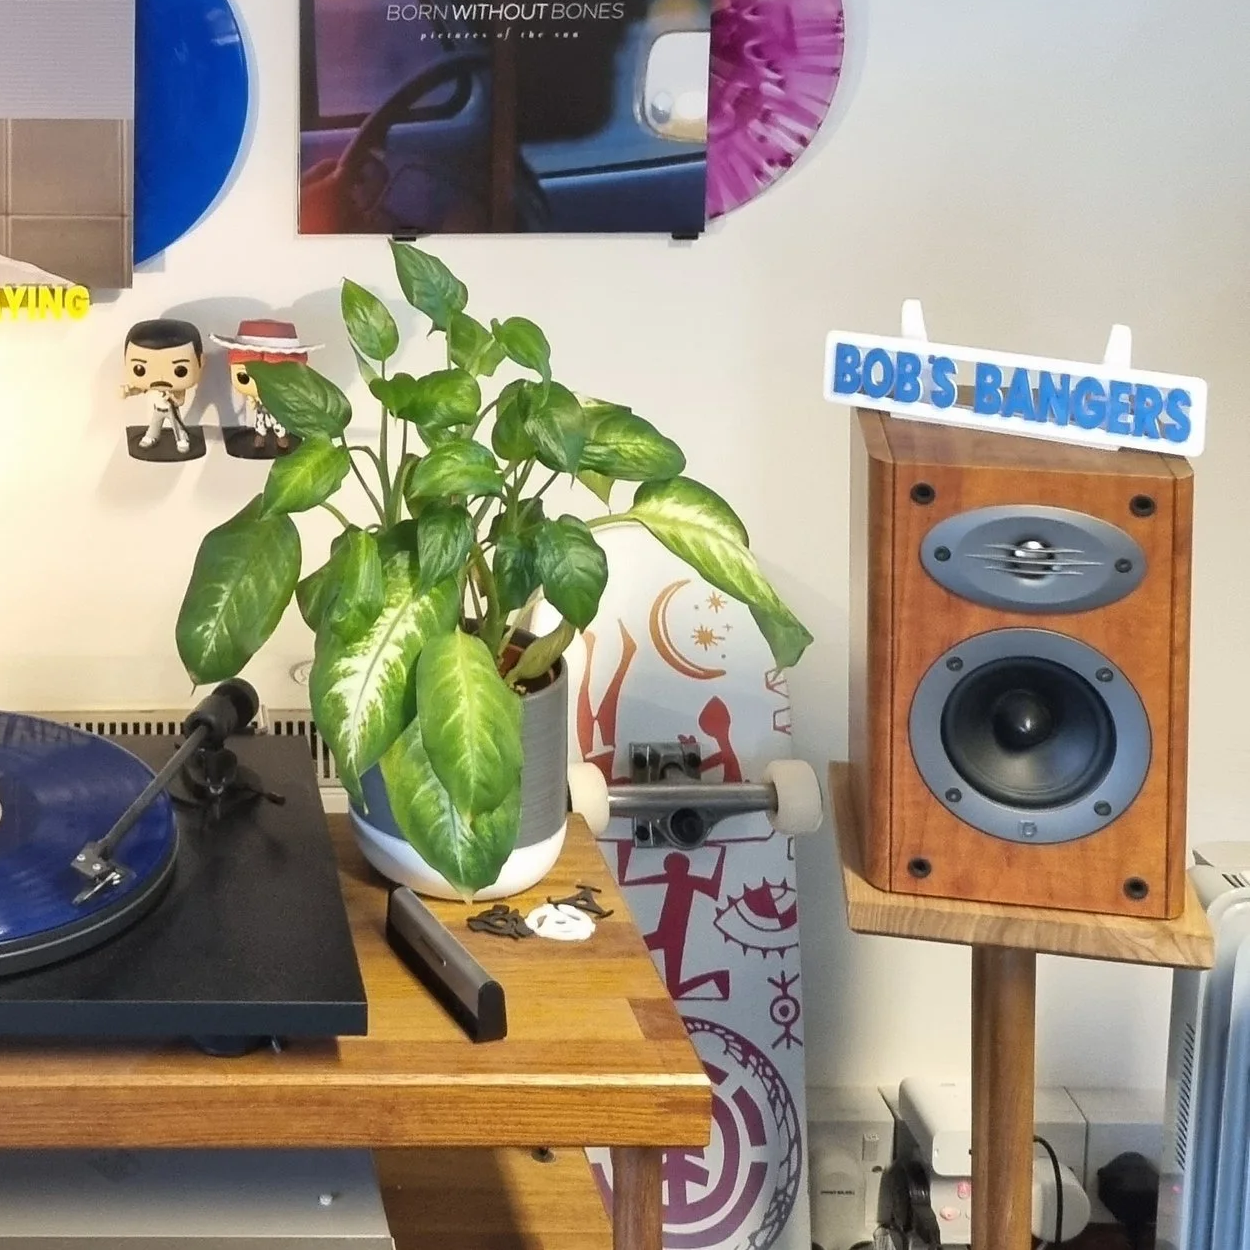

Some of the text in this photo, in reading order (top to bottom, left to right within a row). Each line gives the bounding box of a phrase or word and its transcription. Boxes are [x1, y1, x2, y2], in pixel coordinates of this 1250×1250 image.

[386, 2, 626, 21] BORN WITHOUT BONES
[420, 26, 579, 41] pictures of the sun
[833, 342, 1192, 444] BOB'S BANGERS
